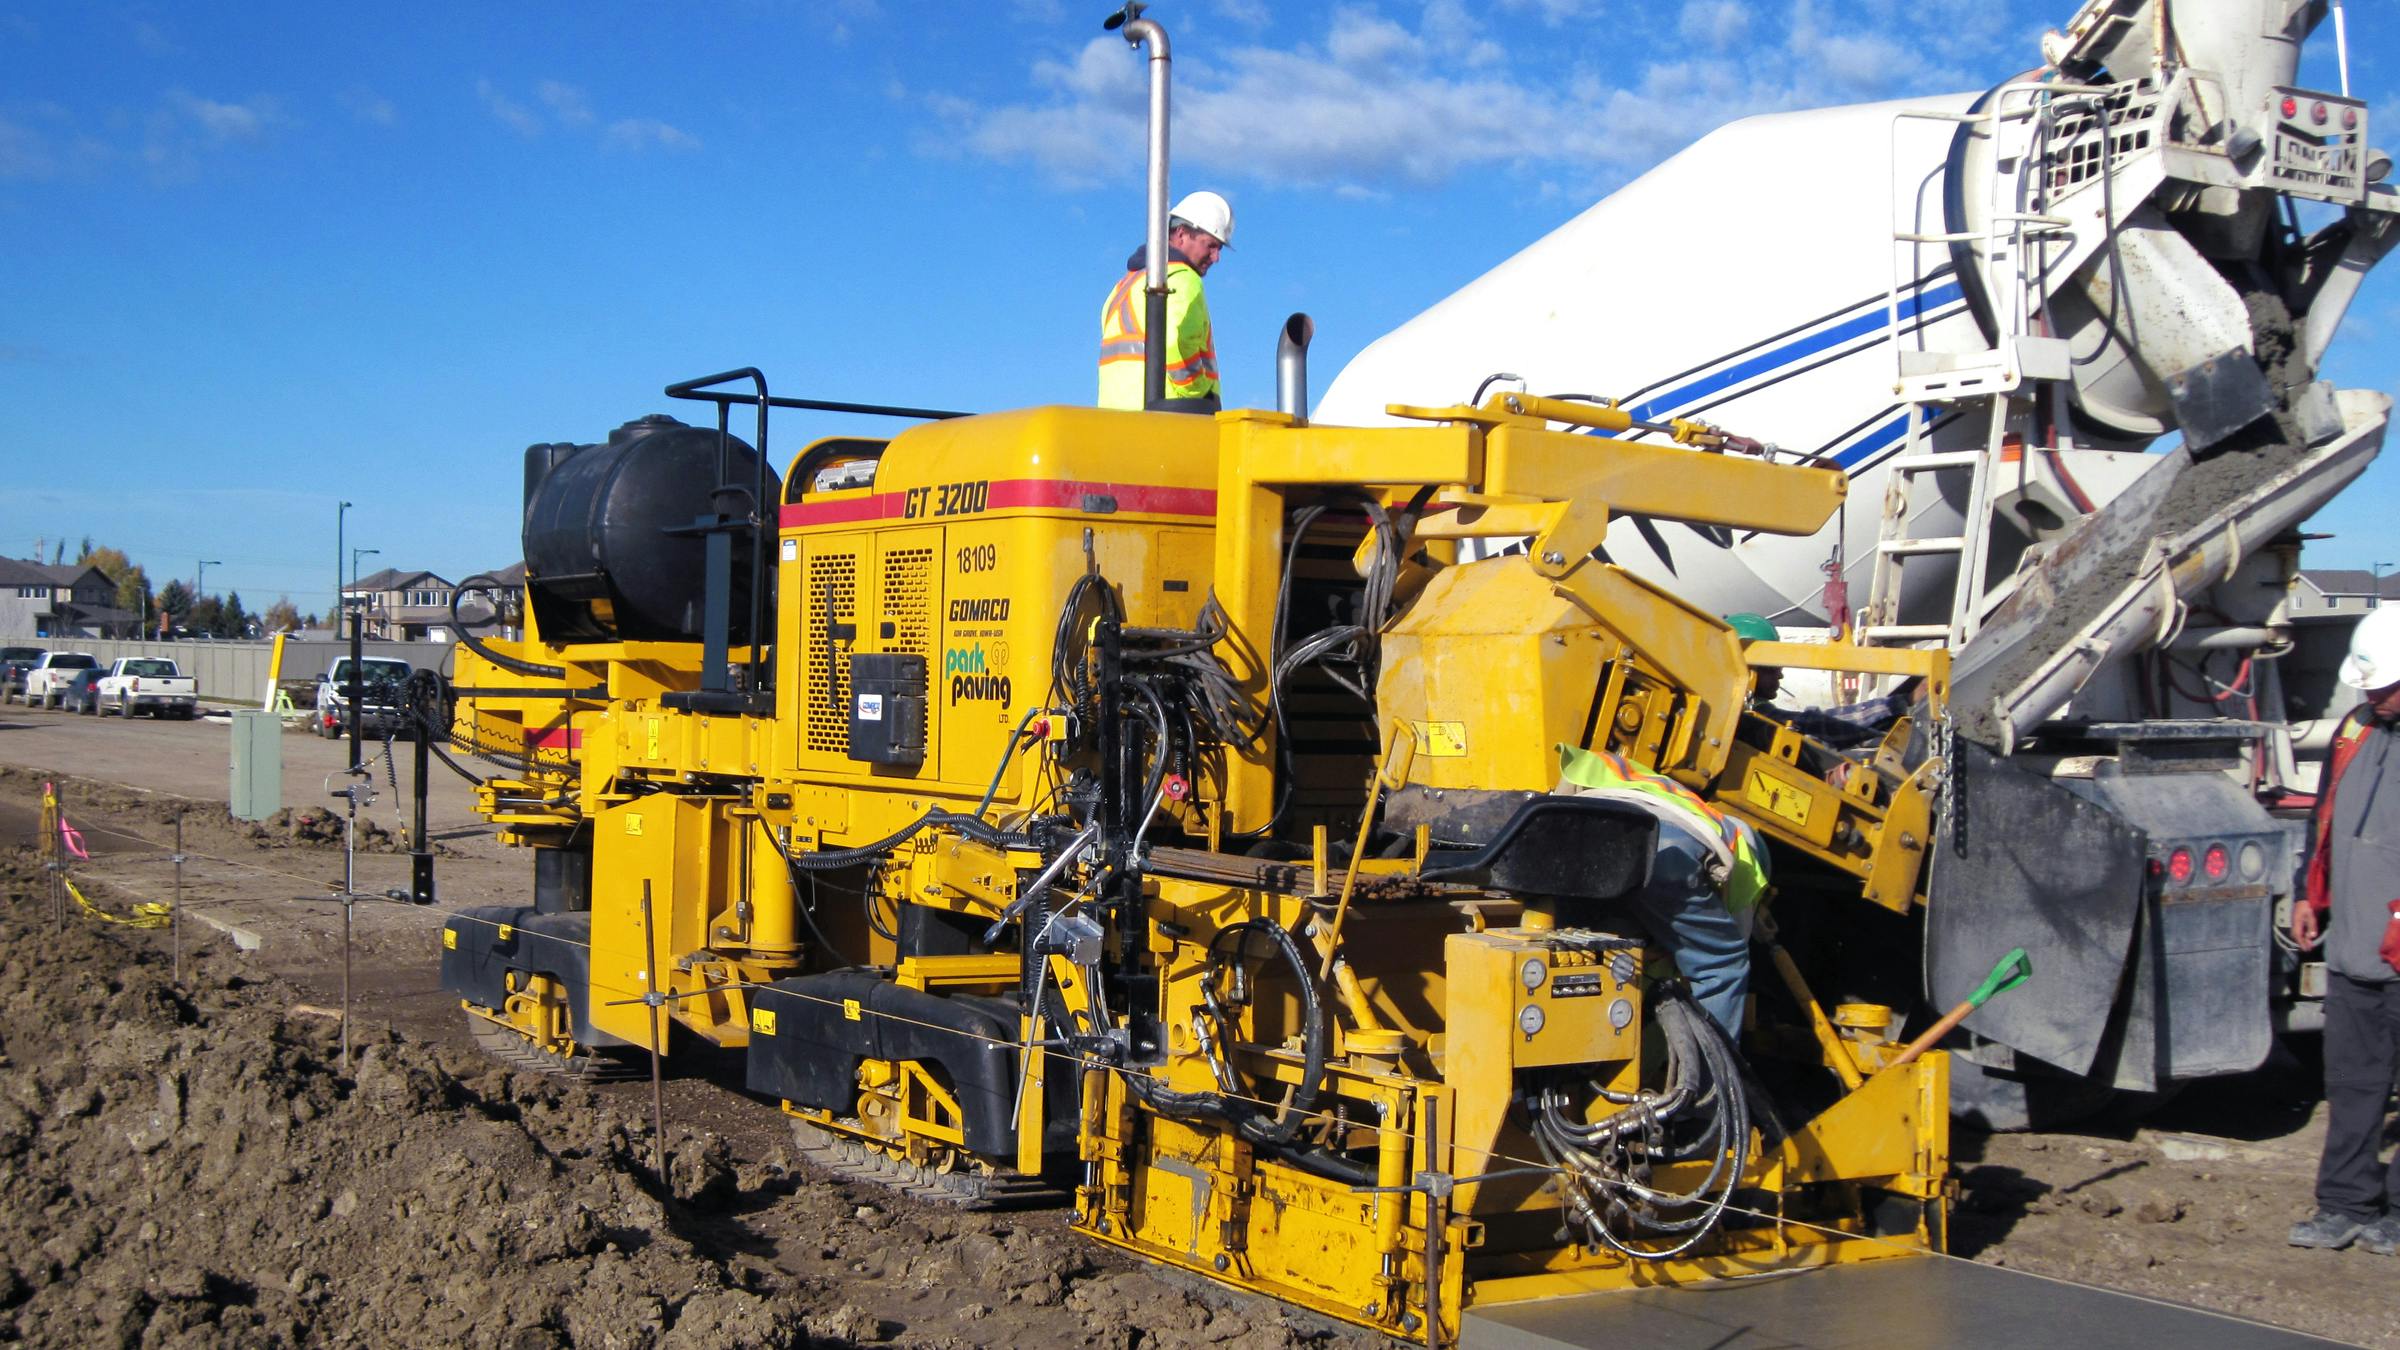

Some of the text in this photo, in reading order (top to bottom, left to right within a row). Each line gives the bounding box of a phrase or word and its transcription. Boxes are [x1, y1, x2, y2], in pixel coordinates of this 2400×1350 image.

[904, 480, 989, 519] GT 3200
[957, 543, 996, 574] 18109
[949, 598, 1010, 622] GOMACO
[946, 641, 985, 680] park
[952, 668, 1011, 710] paving
